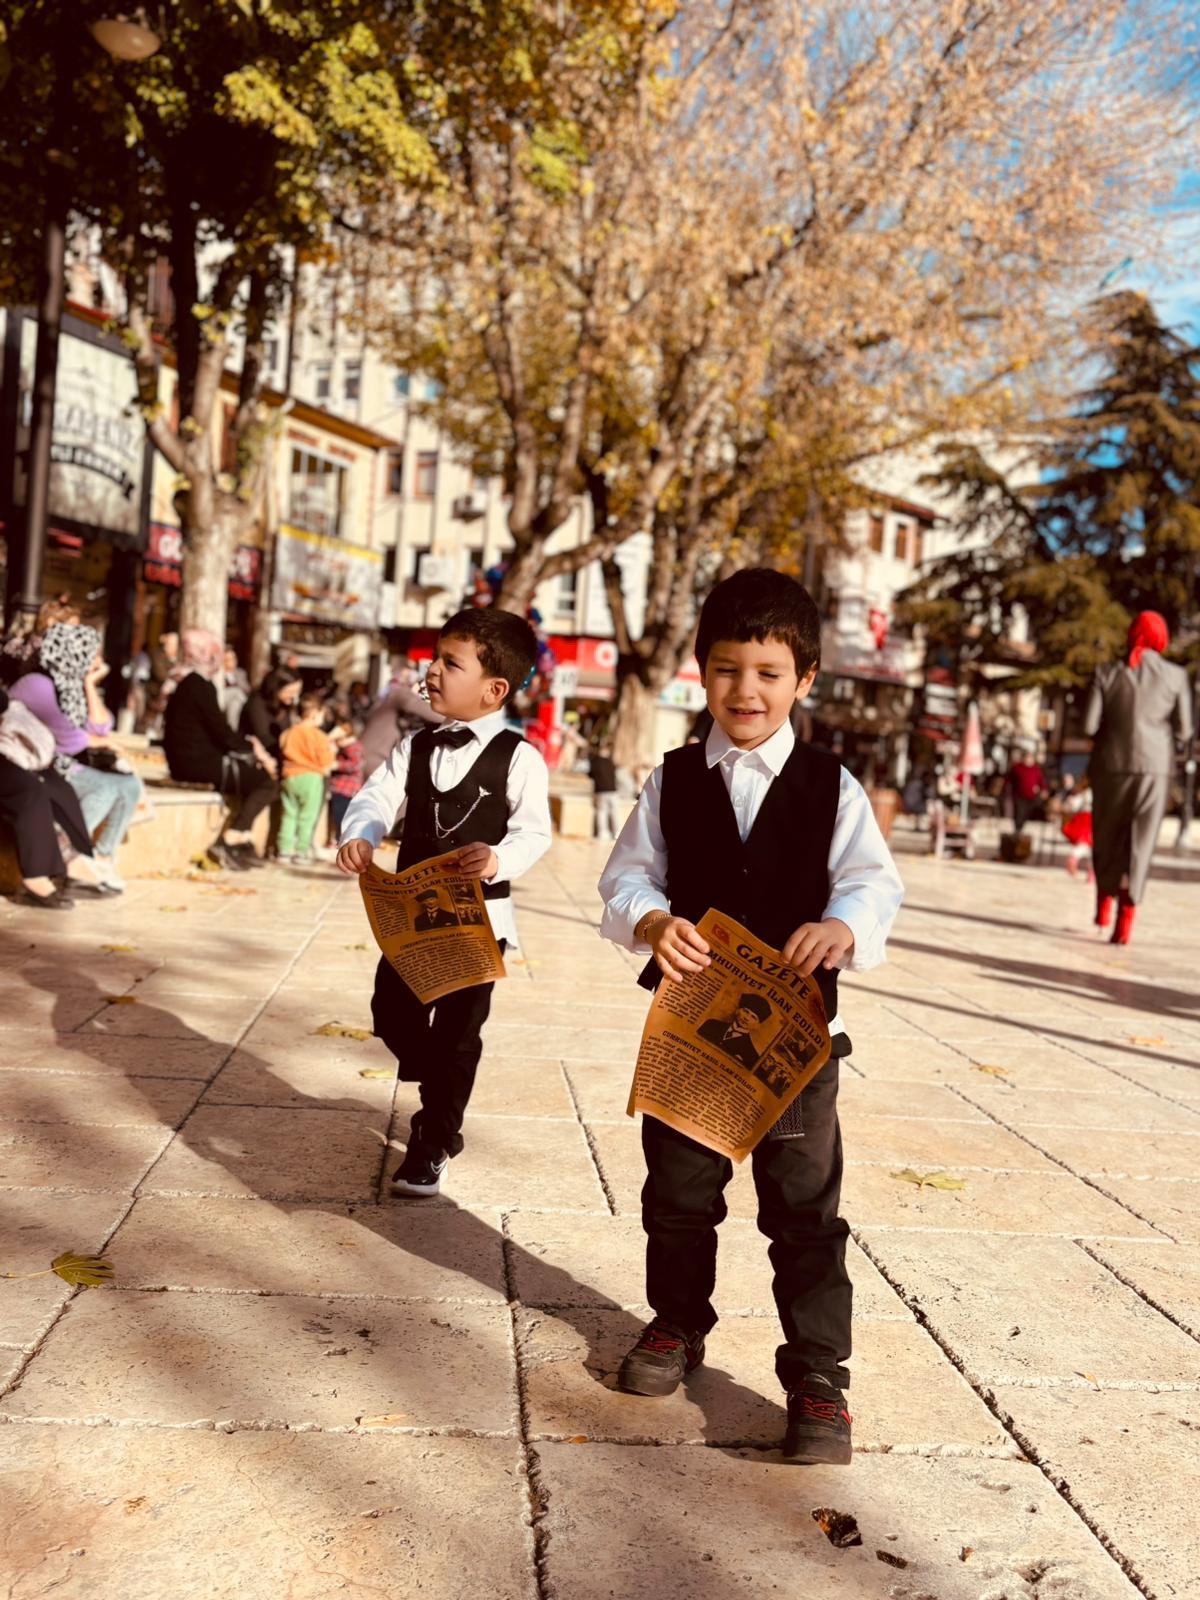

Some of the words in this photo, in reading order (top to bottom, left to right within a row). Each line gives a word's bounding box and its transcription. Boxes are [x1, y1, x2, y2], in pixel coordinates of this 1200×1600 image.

[382, 865, 440, 886] GAZETE
[706, 949, 766, 990] MHURİYET
[767, 985, 793, 1013] İLAN
[736, 944, 811, 999] GAZETE
